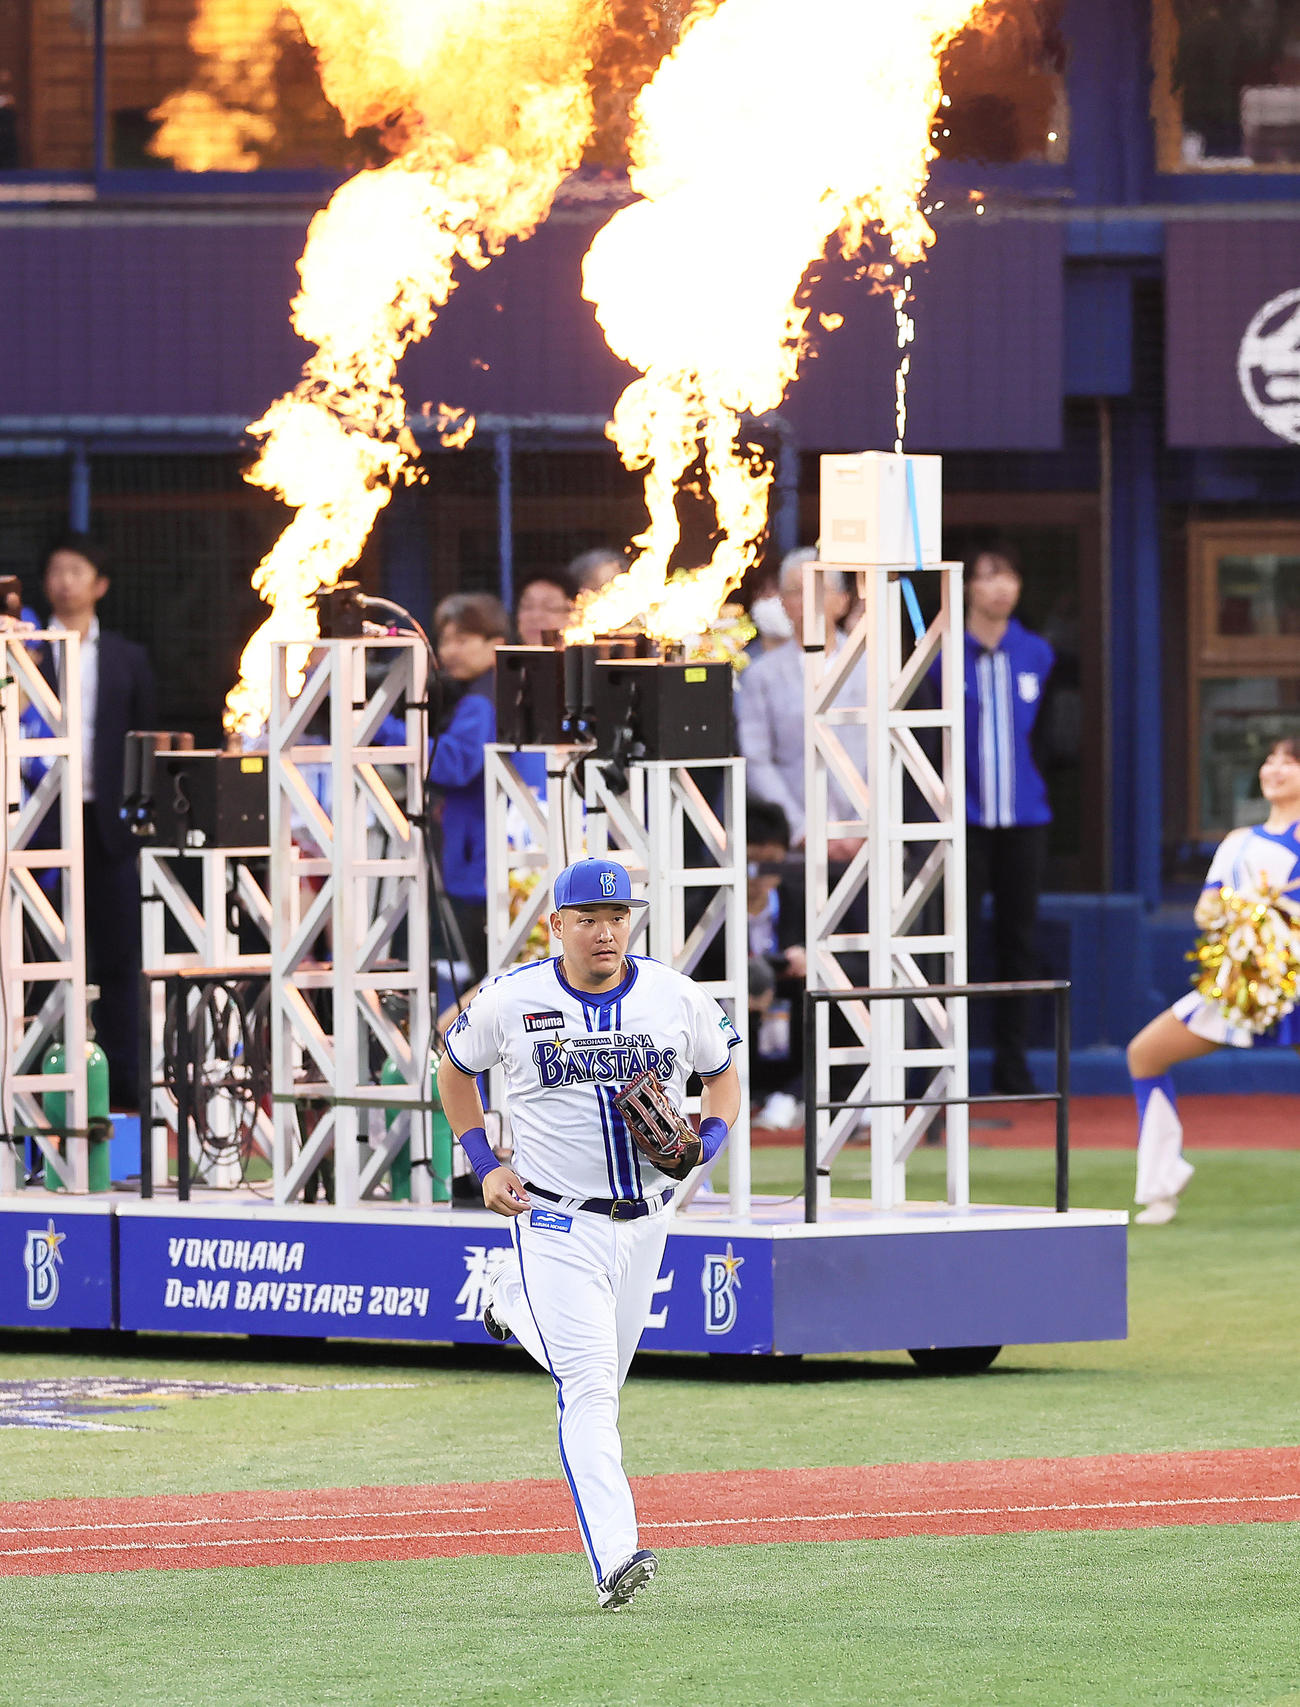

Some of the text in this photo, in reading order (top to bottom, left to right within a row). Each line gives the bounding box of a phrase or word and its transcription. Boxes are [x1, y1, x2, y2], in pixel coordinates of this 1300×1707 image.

[600, 872, 616, 897] B
[524, 1015, 564, 1030] nojima
[572, 1034, 654, 1047] YOKOHAMA DeNA
[532, 1040, 677, 1088] BAYSTARS
[168, 1237, 305, 1274] YOKOHAMA
[164, 1278, 430, 1318] DeNA BAYSTARS 2024
